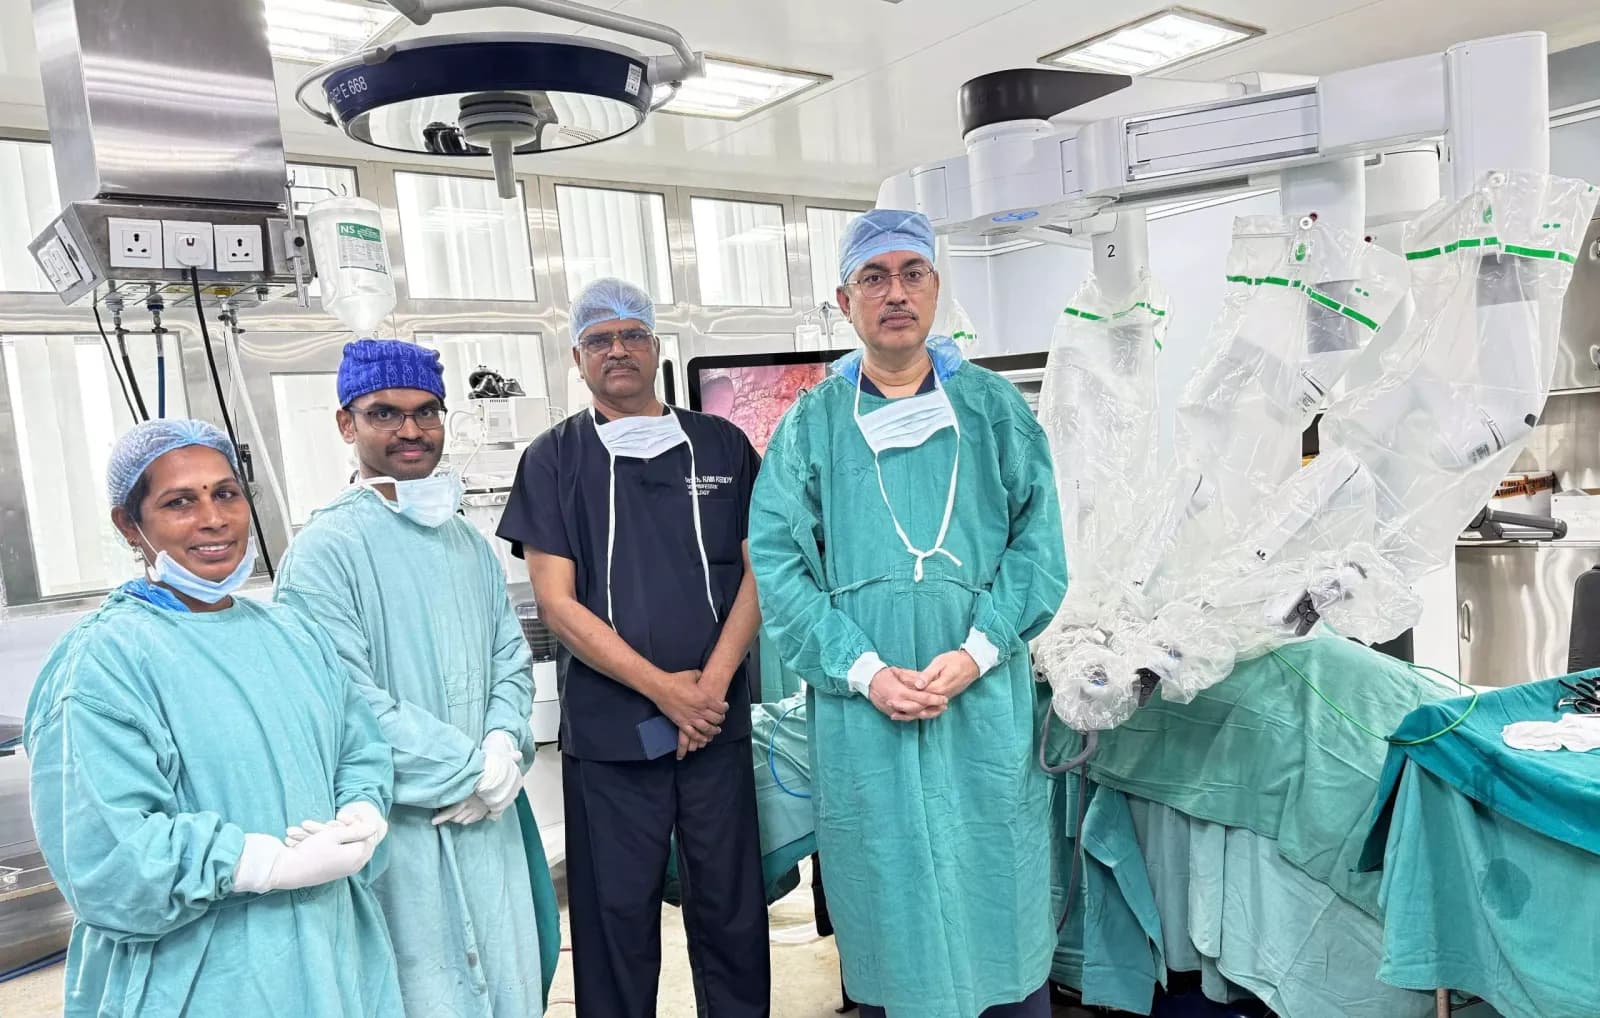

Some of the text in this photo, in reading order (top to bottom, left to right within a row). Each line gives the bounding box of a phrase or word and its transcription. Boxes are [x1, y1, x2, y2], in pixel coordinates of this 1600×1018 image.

[339, 83, 350, 99] E
[347, 76, 368, 95] 668
[340, 225, 355, 234] NS
[1107, 244, 1116, 258] 2
